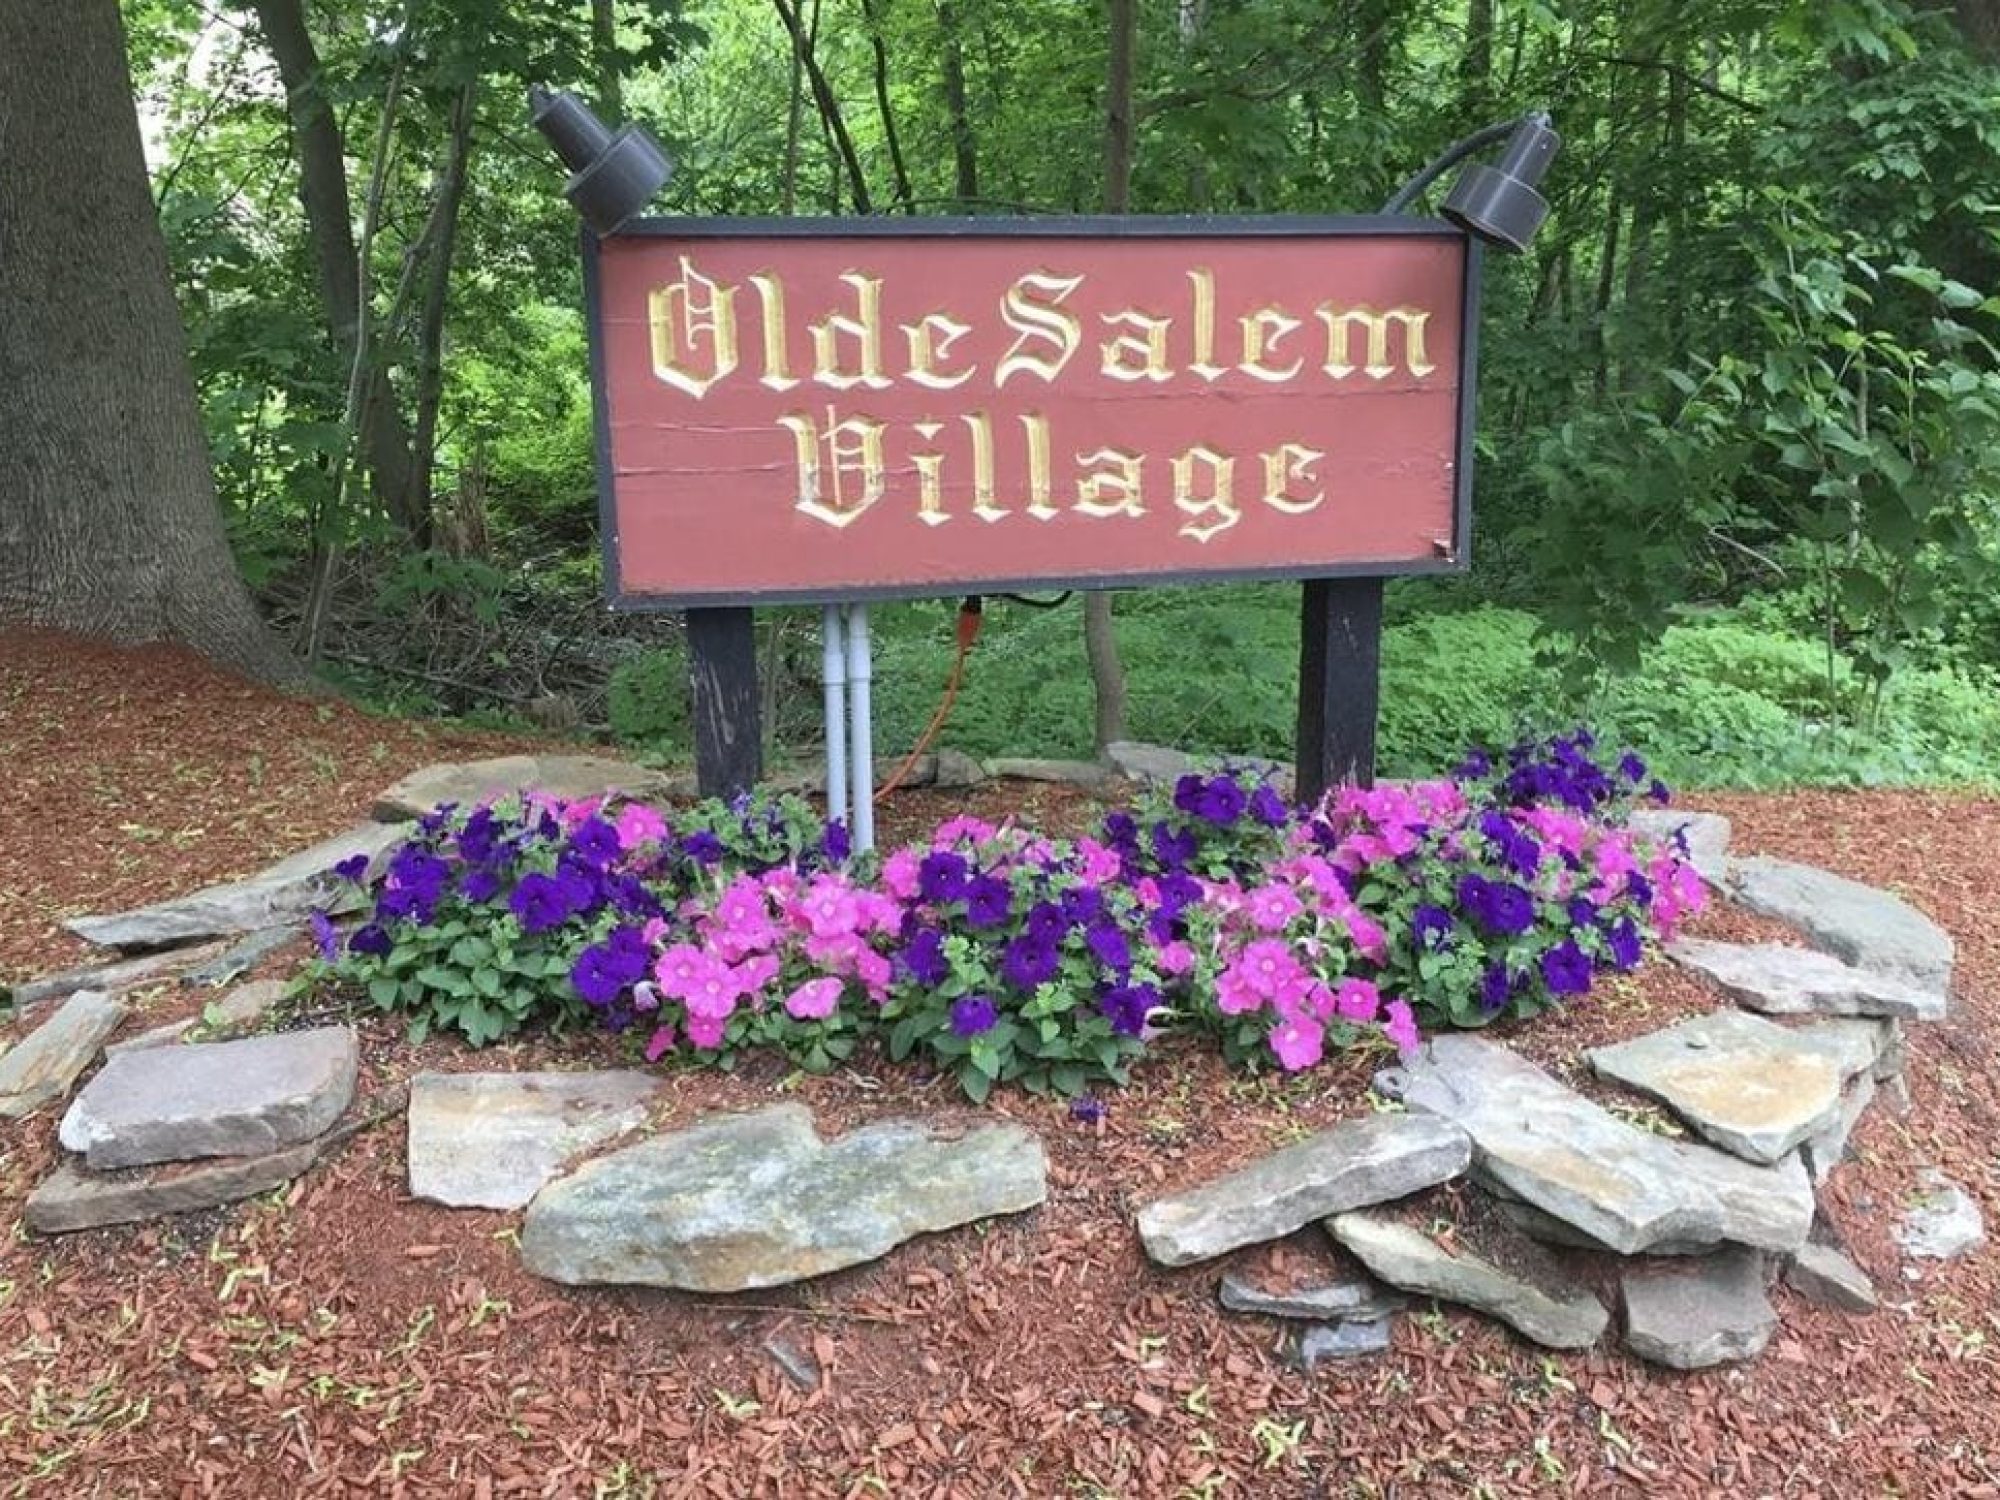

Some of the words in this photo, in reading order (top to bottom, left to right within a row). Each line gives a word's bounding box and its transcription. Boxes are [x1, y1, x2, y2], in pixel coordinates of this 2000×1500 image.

[647, 255, 977, 399] Olde
[994, 266, 1437, 388] Salem
[776, 404, 1326, 542] Village
